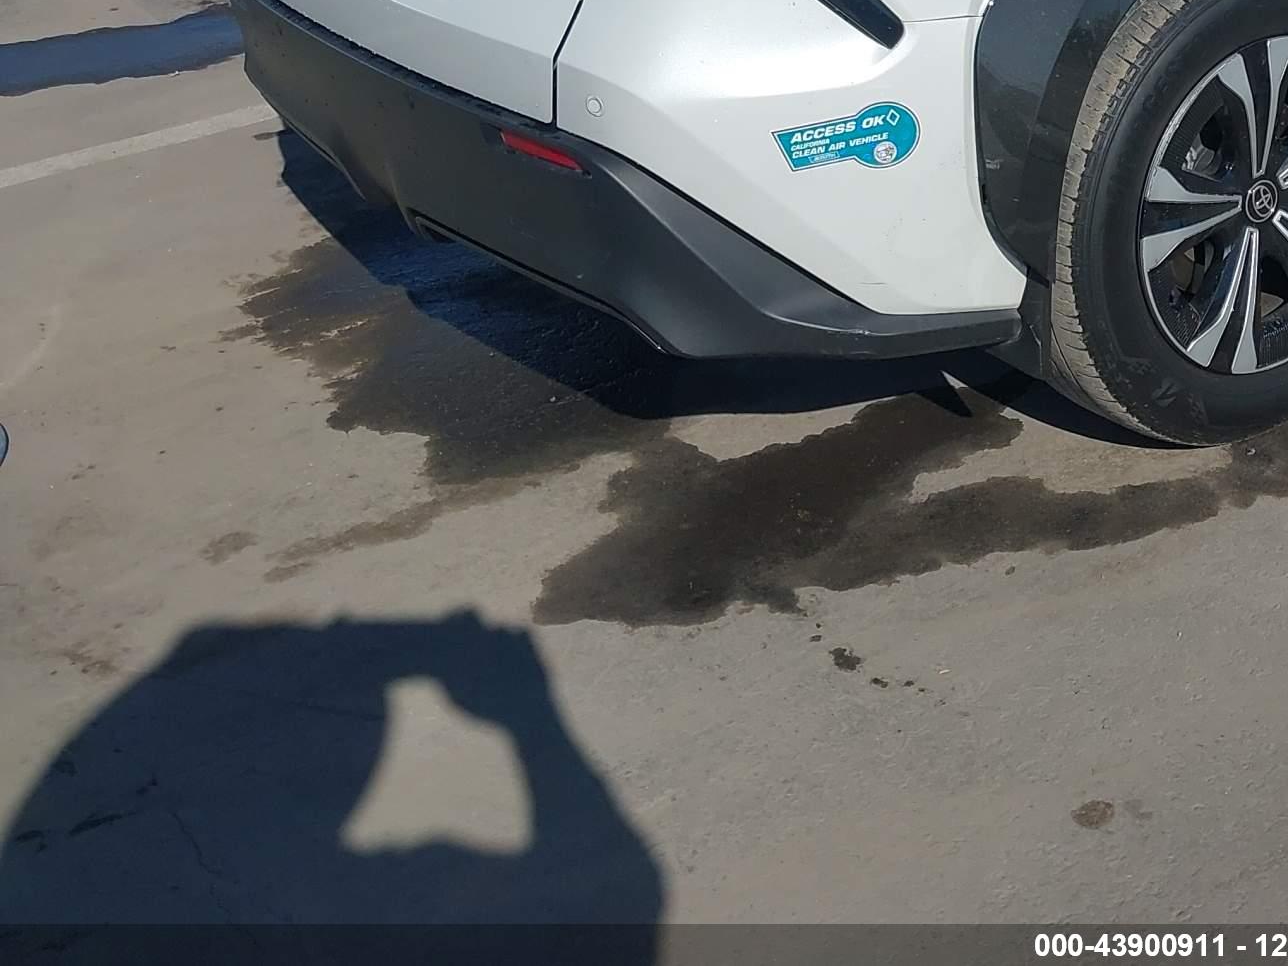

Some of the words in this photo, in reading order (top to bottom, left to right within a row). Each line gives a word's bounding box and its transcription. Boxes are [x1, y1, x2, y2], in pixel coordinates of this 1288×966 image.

[790, 121, 856, 144] ACCESS
[862, 115, 886, 129] OK
[790, 138, 830, 152] CALIFORNIA
[792, 146, 826, 159] CLEAN
[828, 141, 846, 152] AIR
[849, 132, 889, 147] VEHICLE
